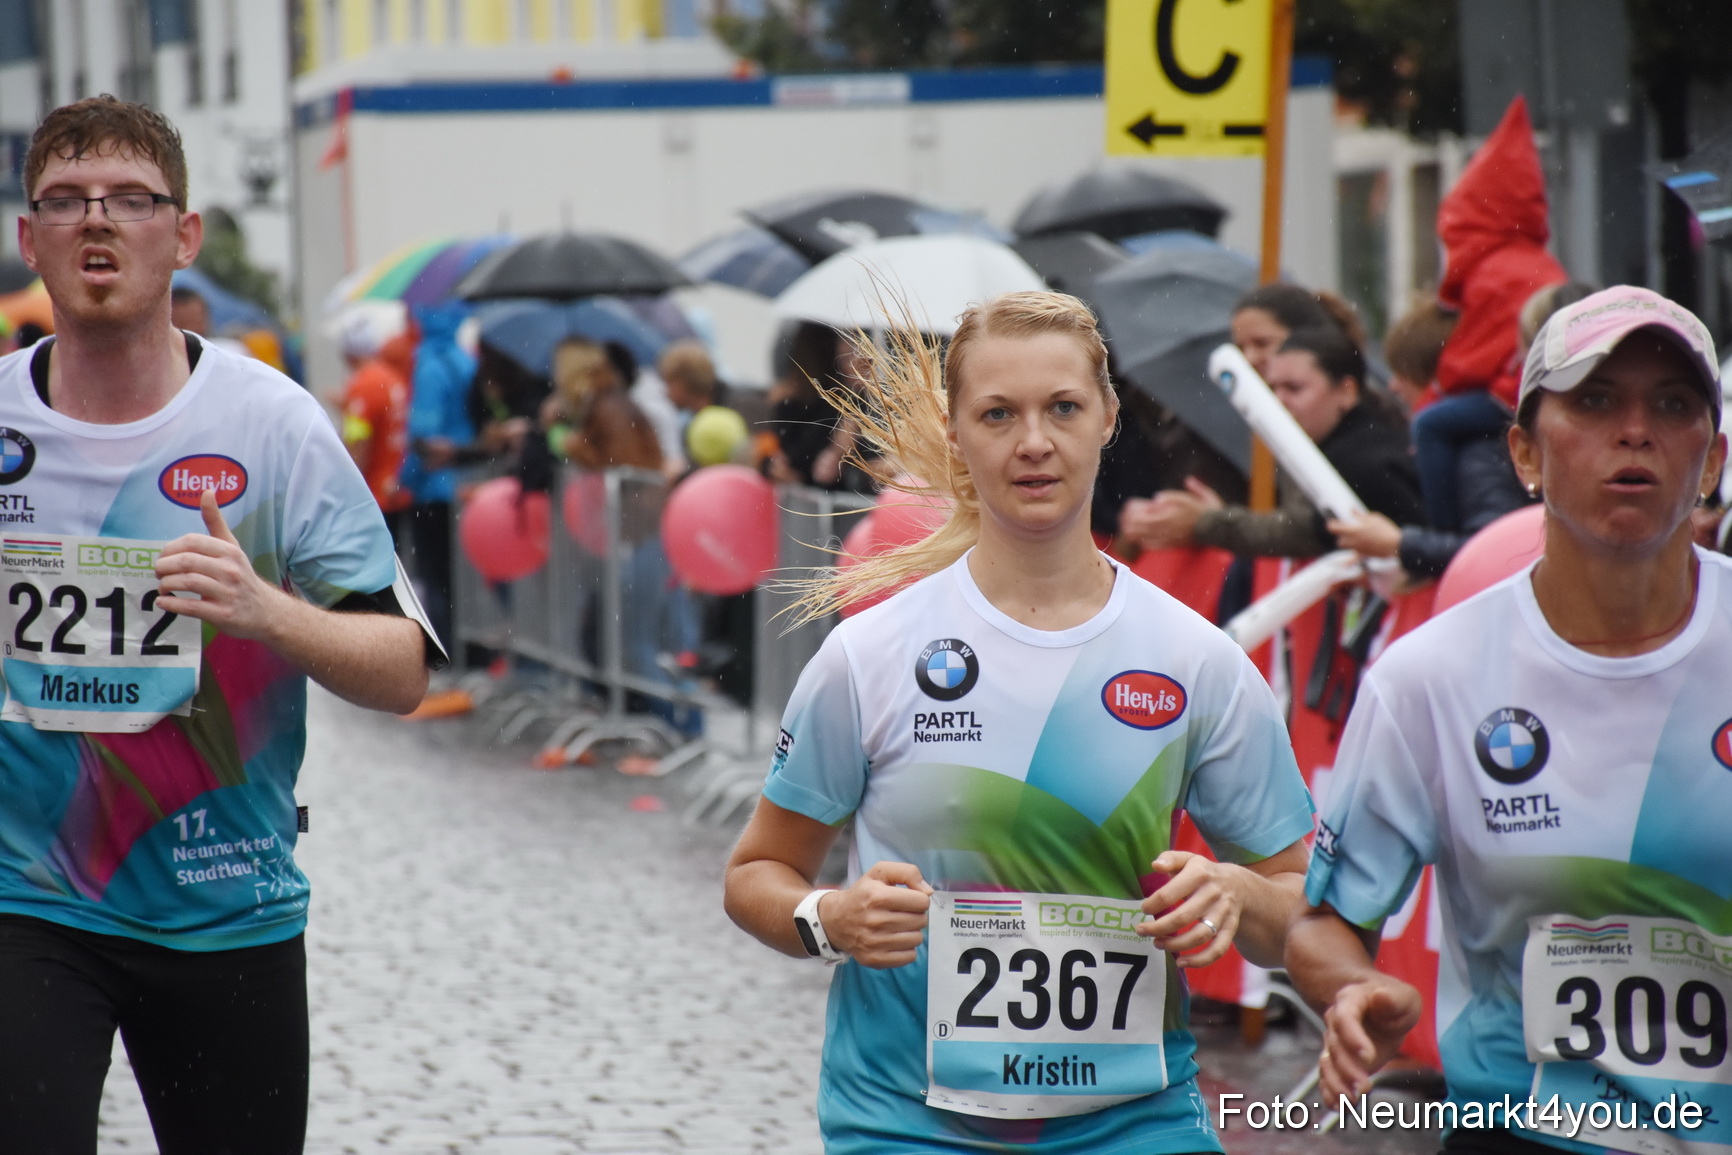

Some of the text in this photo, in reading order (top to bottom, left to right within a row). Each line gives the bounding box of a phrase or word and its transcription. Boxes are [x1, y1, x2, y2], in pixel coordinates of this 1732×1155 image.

[1156, 0, 1241, 95] C
[173, 469, 239, 494] Hervis
[0, 494, 35, 511] RTL
[0, 512, 35, 523] markt
[1, 555, 65, 569] NeuerMarkt
[78, 544, 162, 570] BOC
[9, 581, 179, 656] 2212
[921, 640, 974, 661] BMW
[40, 674, 140, 704] Markus
[1115, 683, 1177, 715] Hervis
[914, 711, 983, 730] PARTL
[1479, 709, 1542, 738] BMW
[914, 729, 982, 743] Neumarkt
[1481, 793, 1560, 818] PARTL
[173, 808, 216, 842] 17.
[1486, 814, 1561, 835] Neumarkt
[173, 835, 275, 863] Neumarkter
[176, 857, 261, 886] Stadtlauf
[950, 917, 1026, 931] NeuerMarkt
[1039, 929, 1071, 938] inspired
[1073, 929, 1084, 938] by
[1085, 930, 1111, 939] smart
[1546, 943, 1633, 957] NeuerMarkt
[956, 947, 1149, 1031] 2367
[1554, 976, 1728, 1069] 309
[1002, 1053, 1097, 1087] Kristin
